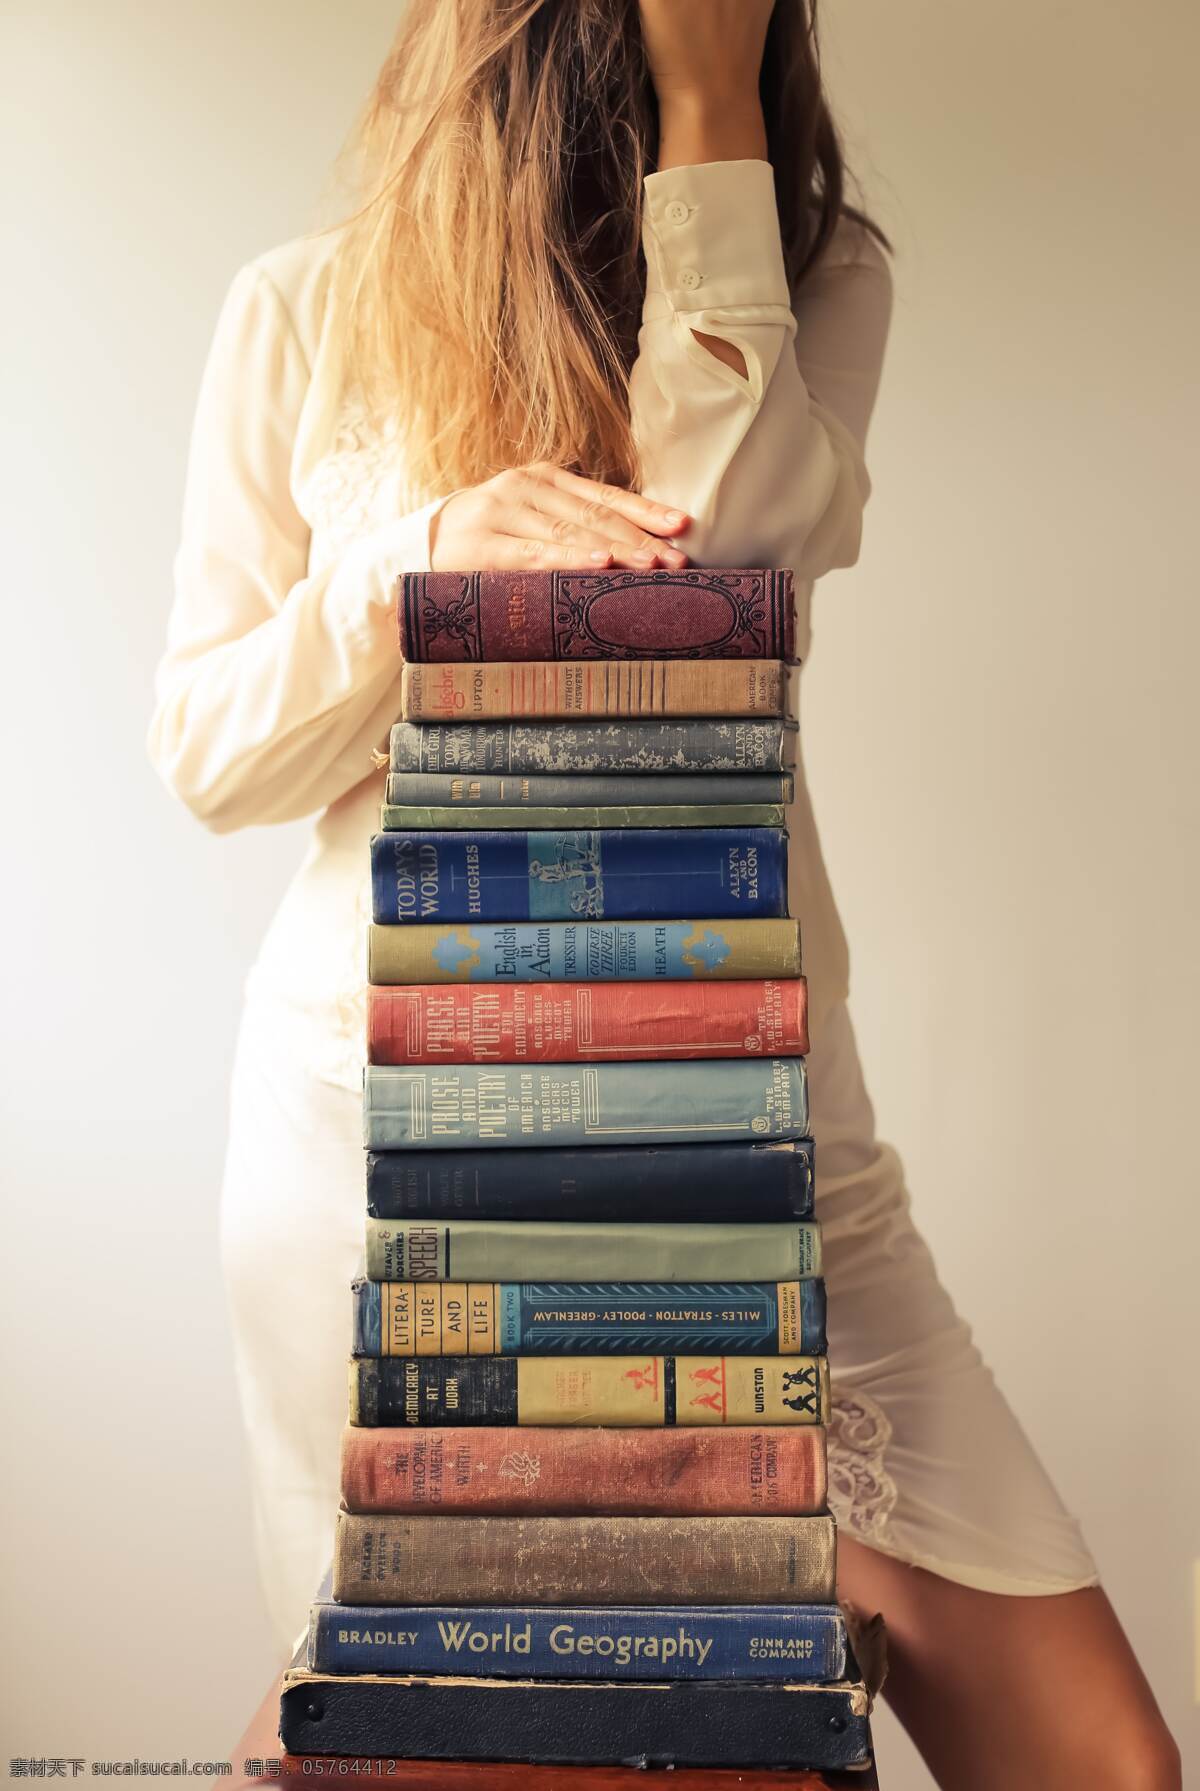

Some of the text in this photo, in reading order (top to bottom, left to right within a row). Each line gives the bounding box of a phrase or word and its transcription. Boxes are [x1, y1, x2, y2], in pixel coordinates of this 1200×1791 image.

[473, 669, 483, 711] UPTON
[565, 667, 573, 709] WITHOUT
[575, 667, 583, 710] ANSWERS
[748, 666, 757, 709] AMERICAN
[495, 728, 504, 767] HUNTER
[735, 725, 746, 768] ALLYN
[746, 733, 754, 757] AND
[754, 725, 765, 768] BACON
[420, 844, 440, 917] WORLD
[466, 845, 481, 914] HUGHES
[729, 847, 740, 899] ALLYN
[740, 859, 748, 880] AND
[747, 847, 758, 899] BACON
[494, 927, 519, 976] English
[516, 944, 533, 959] in
[528, 928, 550, 977] Action
[564, 926, 577, 976] TRESSLER
[589, 927, 600, 976] COURSE
[600, 930, 613, 973] THREE
[620, 931, 628, 971] FOURTH
[628, 931, 637, 972] EDITION
[655, 927, 667, 975] HEATH
[426, 996, 455, 1053] PROSE
[456, 1007, 470, 1041] AND
[472, 991, 500, 1056] POETRY
[501, 1011, 514, 1034] FOR
[514, 989, 527, 1056] ENJOYMENT
[544, 1000, 553, 1040] LUCAS
[564, 999, 573, 1041] TOWER
[757, 1006, 766, 1031] THE
[773, 983, 784, 1047] COMPANY
[431, 1077, 460, 1134] PROSE
[462, 1088, 476, 1121] AND
[478, 1072, 507, 1138] POETRY
[508, 1096, 519, 1111] OF
[520, 1073, 534, 1133] AMERICA
[541, 1075, 551, 1131] ANSORGE
[551, 1082, 561, 1123] LUCAS
[571, 1080, 580, 1123] TOWER
[766, 1087, 774, 1112] THE
[781, 1064, 791, 1128] COMPANY
[408, 1226, 438, 1279] SPEECH
[394, 1288, 409, 1346] LITERA-
[421, 1298, 435, 1337] TURE
[447, 1300, 462, 1333] AND
[474, 1300, 488, 1334] LIFE
[506, 1291, 516, 1342] BOOK TWO
[533, 1311, 761, 1321] MILES STRATTON POOLEY GREENLAW
[406, 1363, 419, 1424] DEMOCRACY
[426, 1386, 439, 1400] AT
[446, 1378, 459, 1409] WORK
[754, 1367, 764, 1413] WINSTON
[430, 1433, 442, 1504] OF AMERIC
[766, 1435, 778, 1478] COMPANY
[337, 1629, 419, 1646] BRADLEY
[437, 1621, 713, 1666] World Geography
[750, 1637, 814, 1649] GINN AND
[750, 1648, 813, 1660] COMPANY
